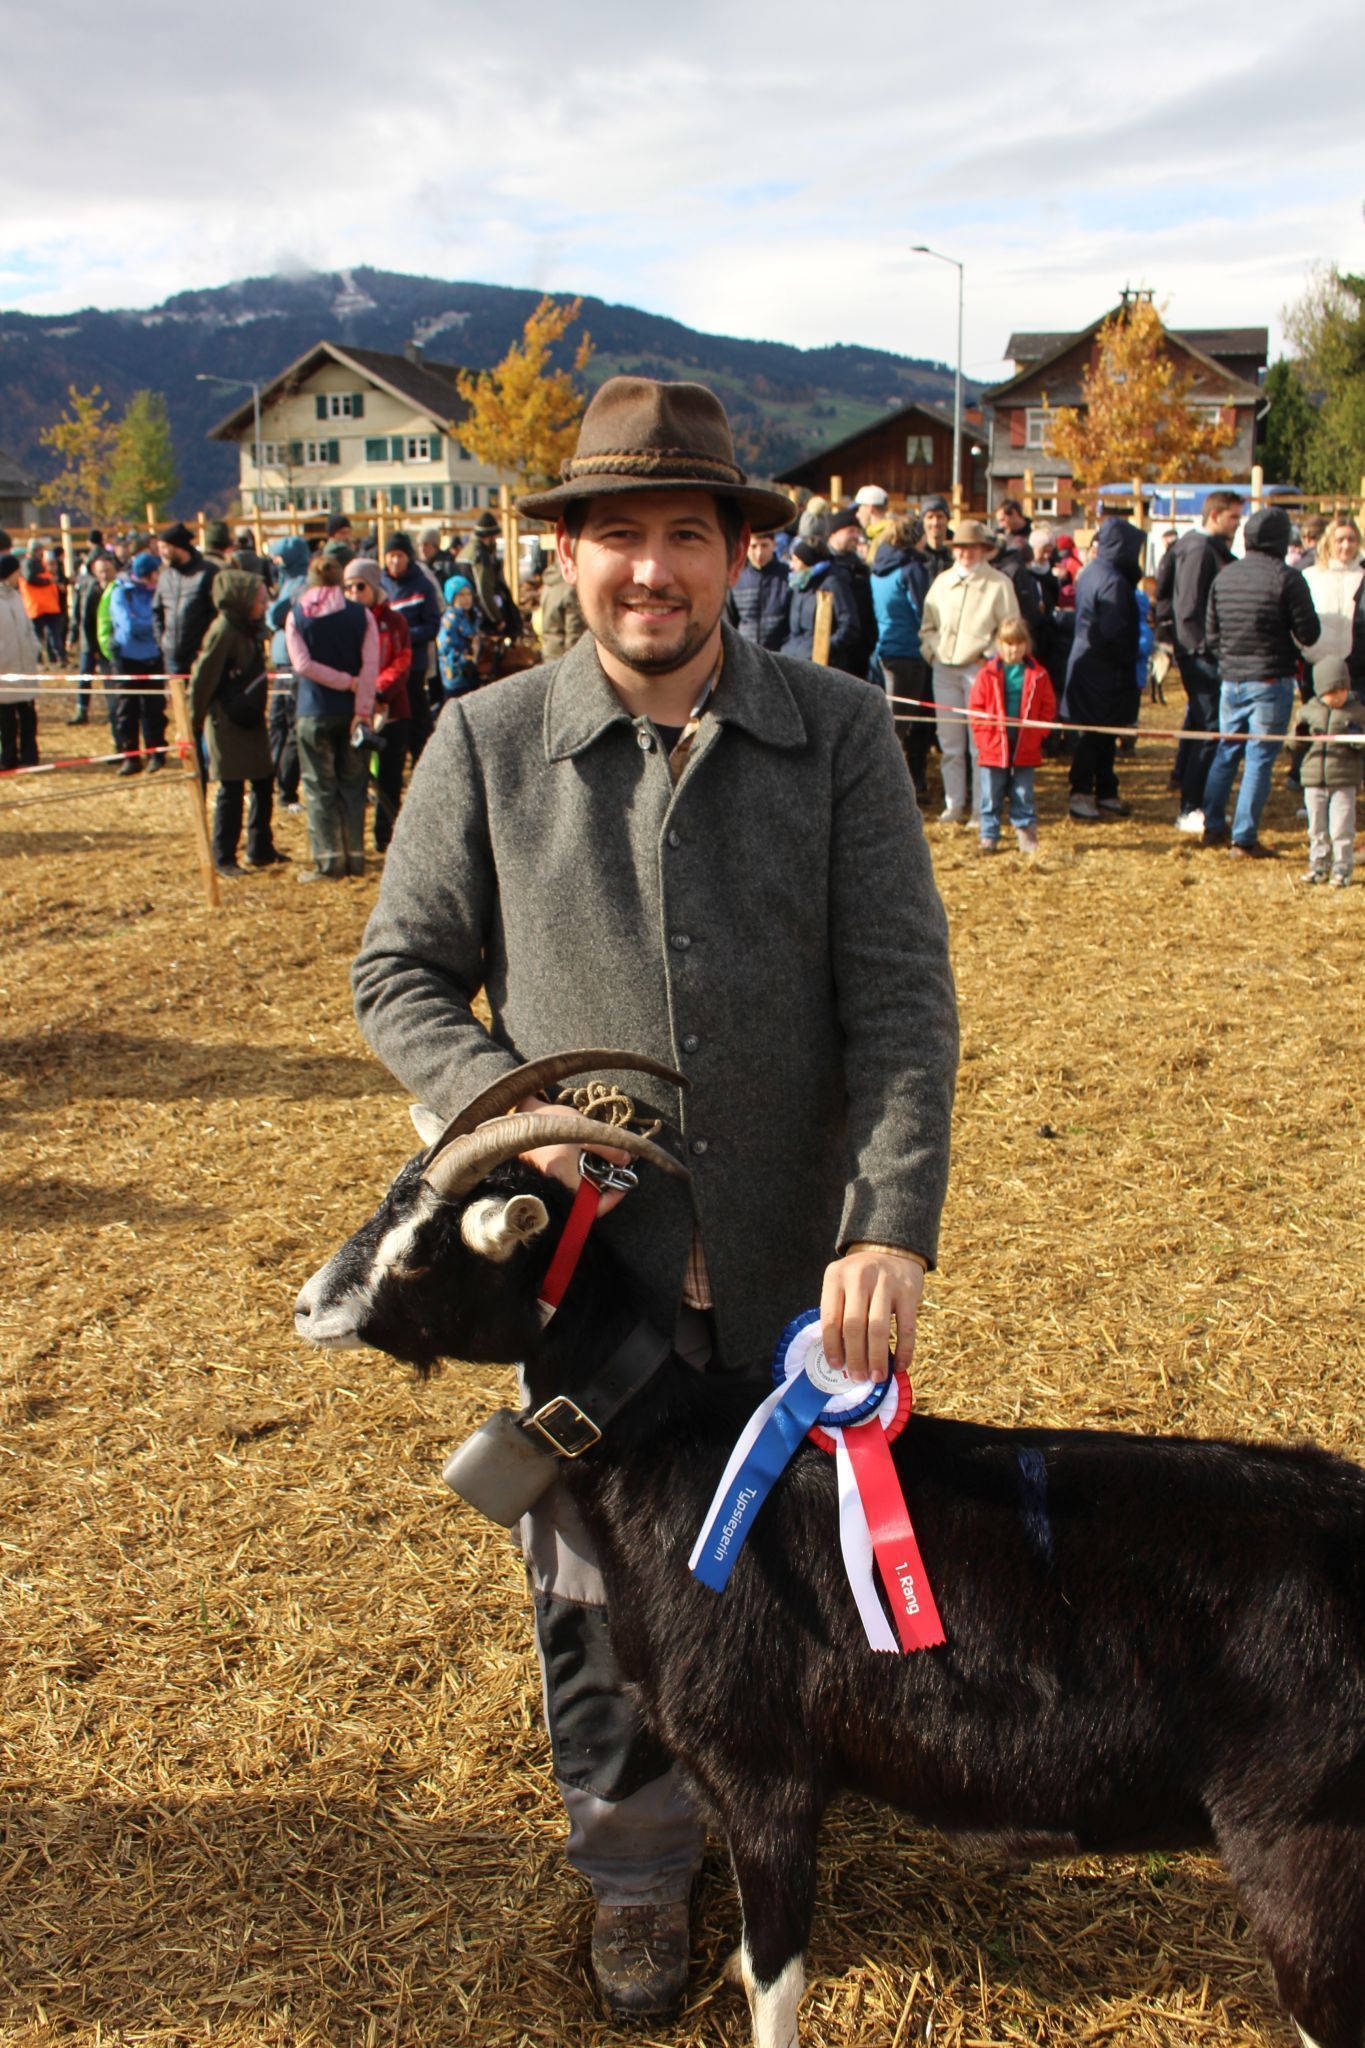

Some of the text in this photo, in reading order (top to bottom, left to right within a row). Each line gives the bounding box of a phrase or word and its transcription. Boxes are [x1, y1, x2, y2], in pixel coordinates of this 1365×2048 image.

[714, 1487, 757, 1561] Typsiegerin
[895, 1562, 920, 1615] 1. Rang
